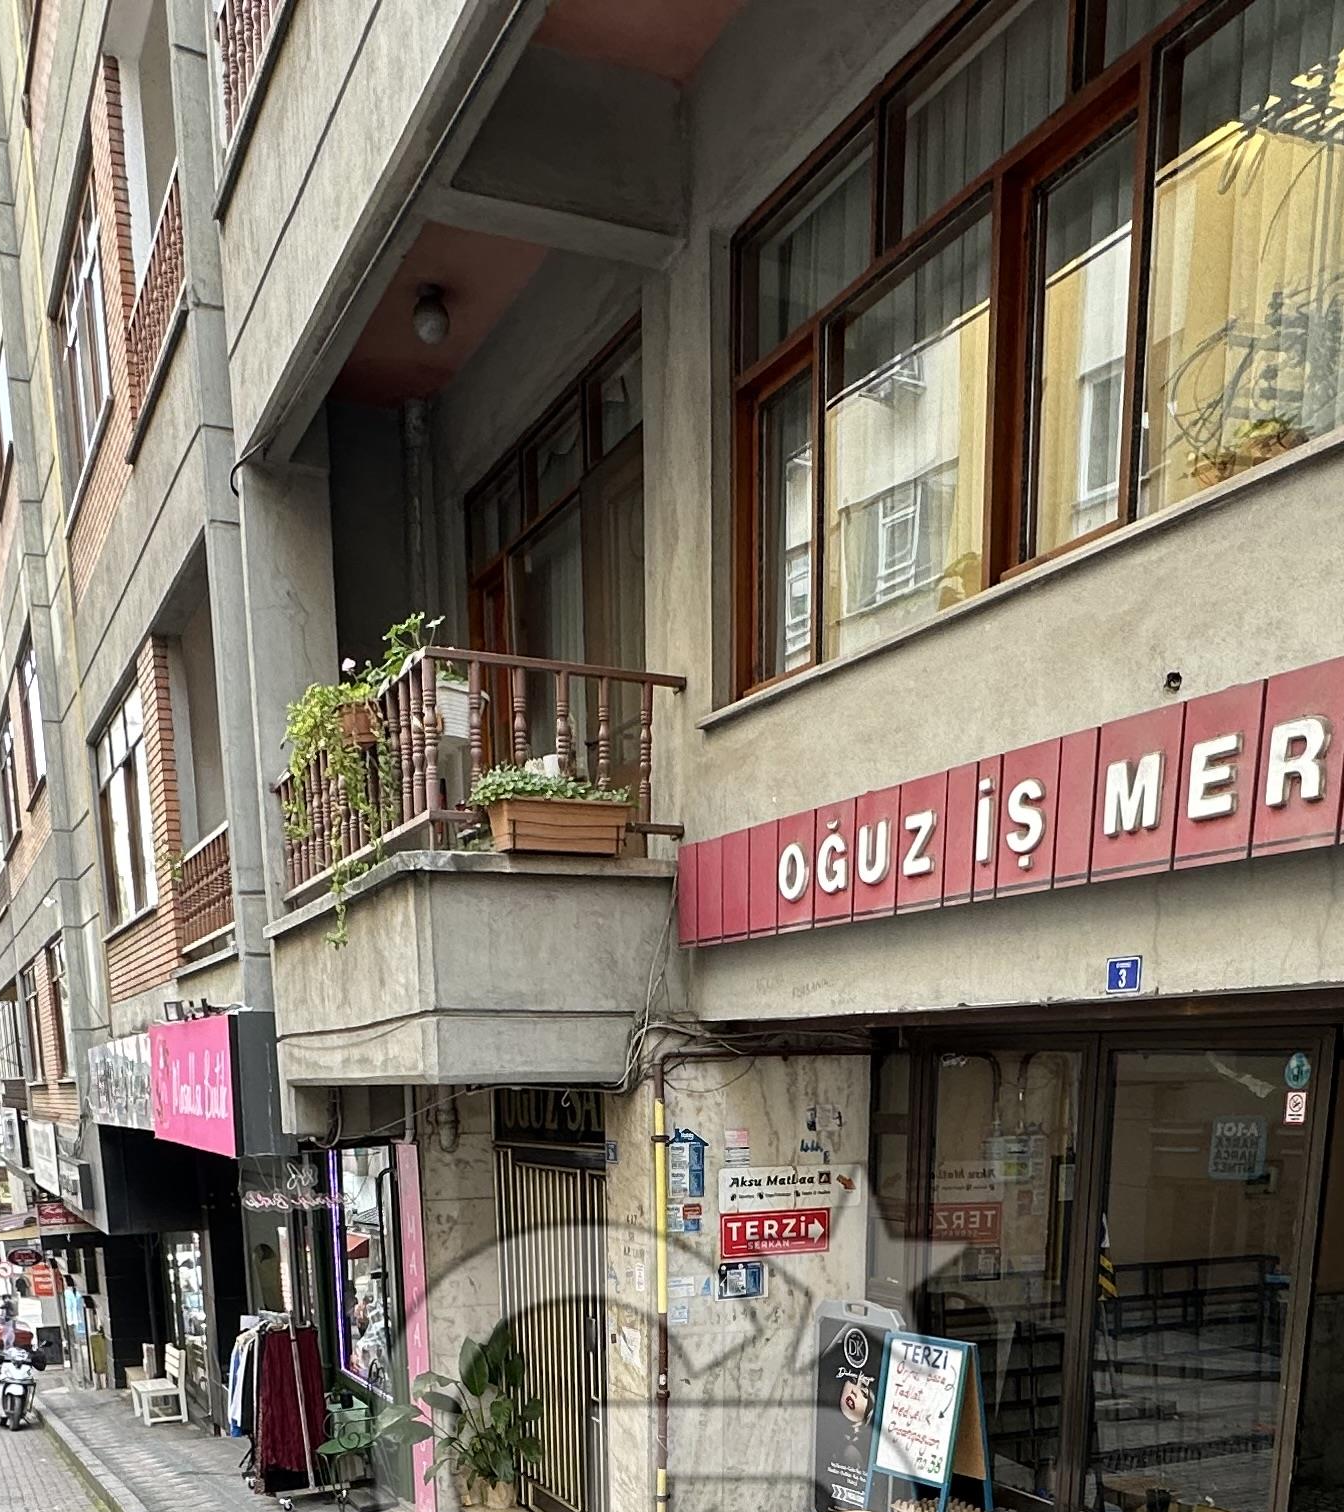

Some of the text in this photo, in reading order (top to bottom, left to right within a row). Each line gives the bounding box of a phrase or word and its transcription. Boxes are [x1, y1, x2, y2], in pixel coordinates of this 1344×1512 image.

[777, 808, 937, 902] OĞUZ
[974, 776, 1046, 872] İŞ
[1118, 968, 1127, 988] 3
[729, 1176, 762, 1188] Aksu
[726, 1215, 807, 1242] TERZİ
[747, 1240, 791, 1250] SERKAN
[901, 1342, 949, 1370] TERZİ
